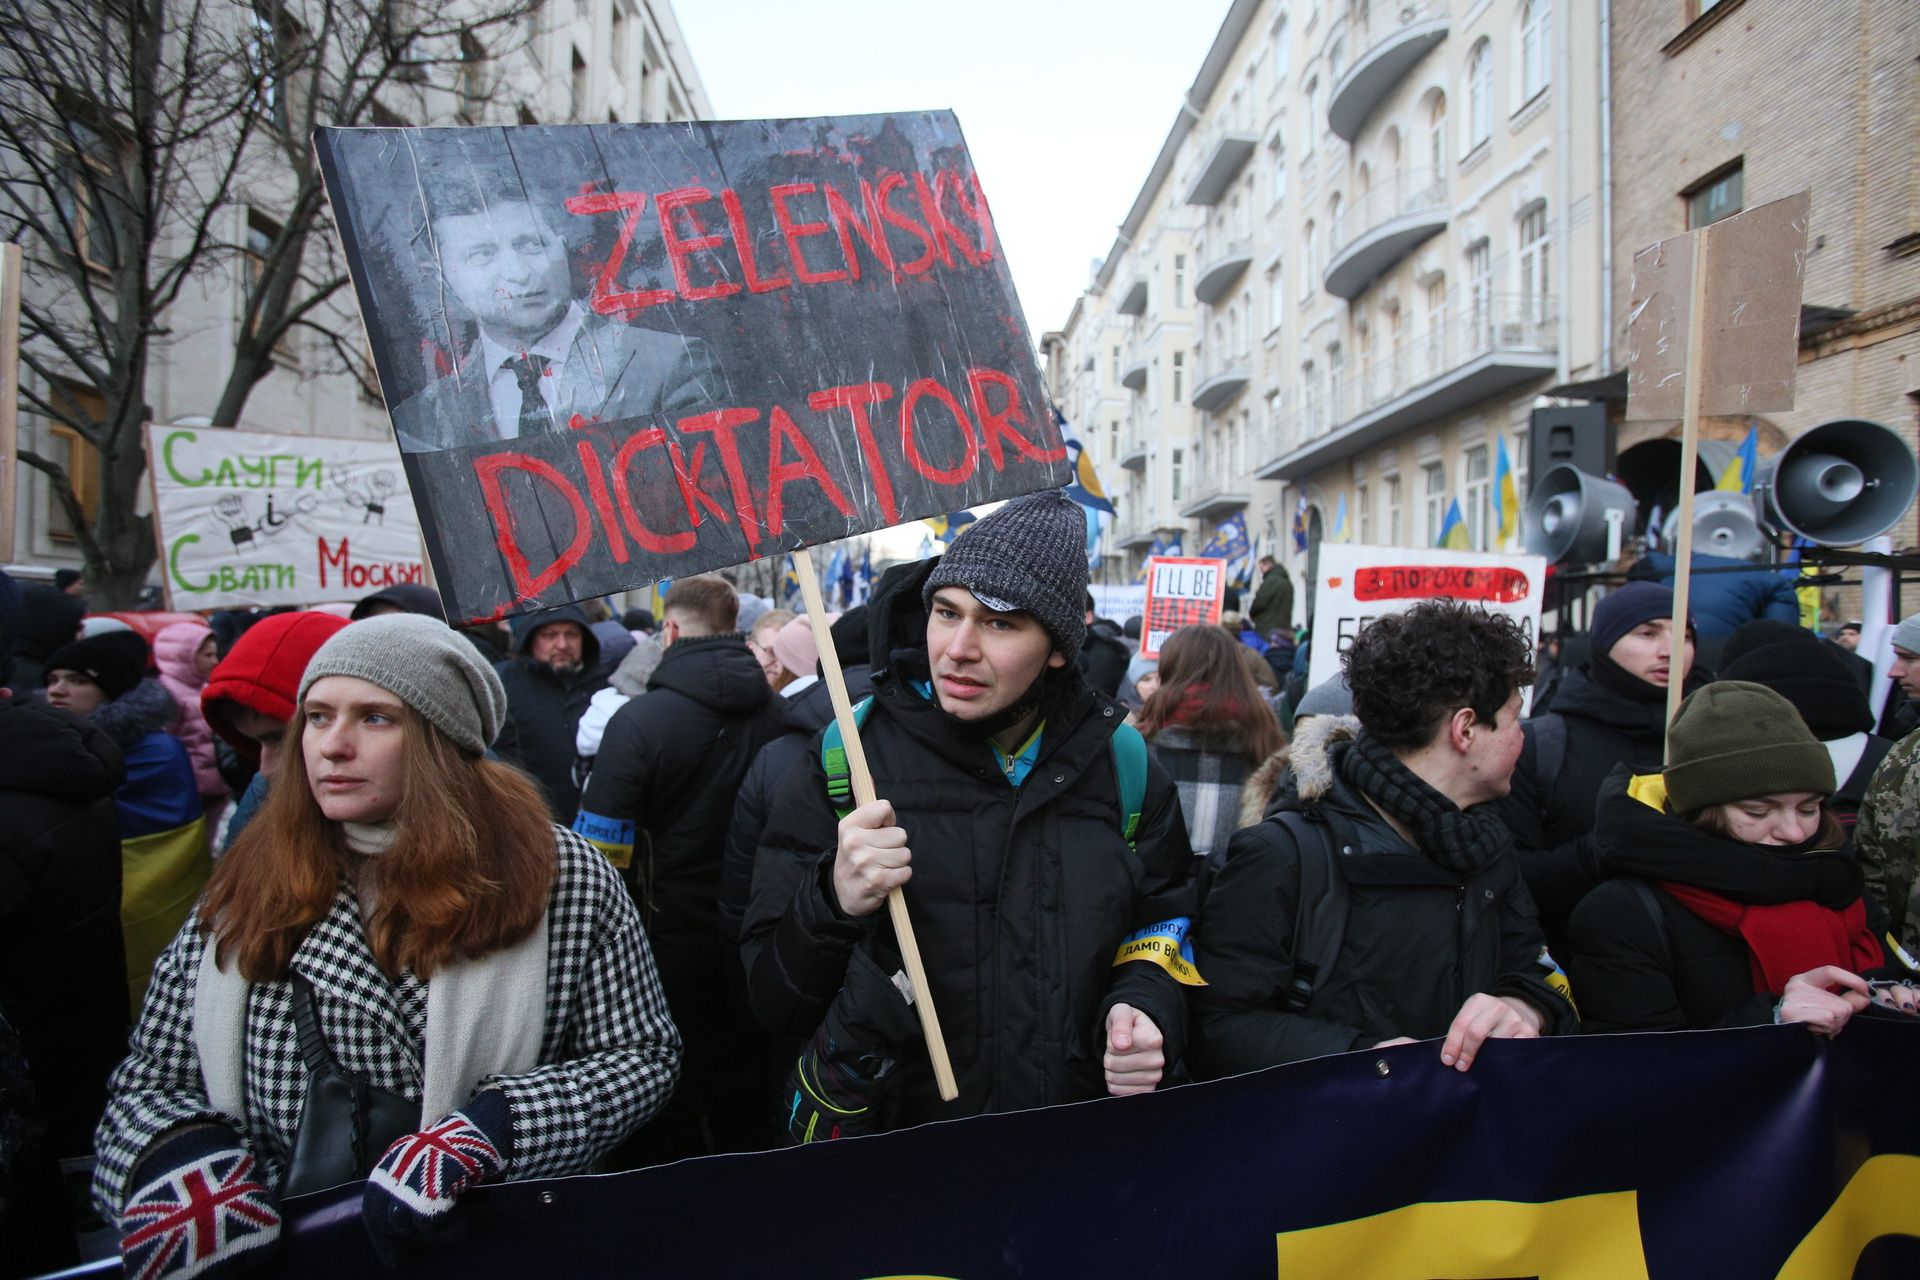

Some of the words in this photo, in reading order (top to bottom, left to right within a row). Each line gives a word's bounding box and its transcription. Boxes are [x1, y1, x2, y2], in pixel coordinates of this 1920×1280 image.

[564, 169, 996, 317] ZELENSKY
[1193, 569, 1215, 597] BE
[1143, 923, 1183, 939] ПОРОХ
[1123, 941, 1161, 956] ДАМО
